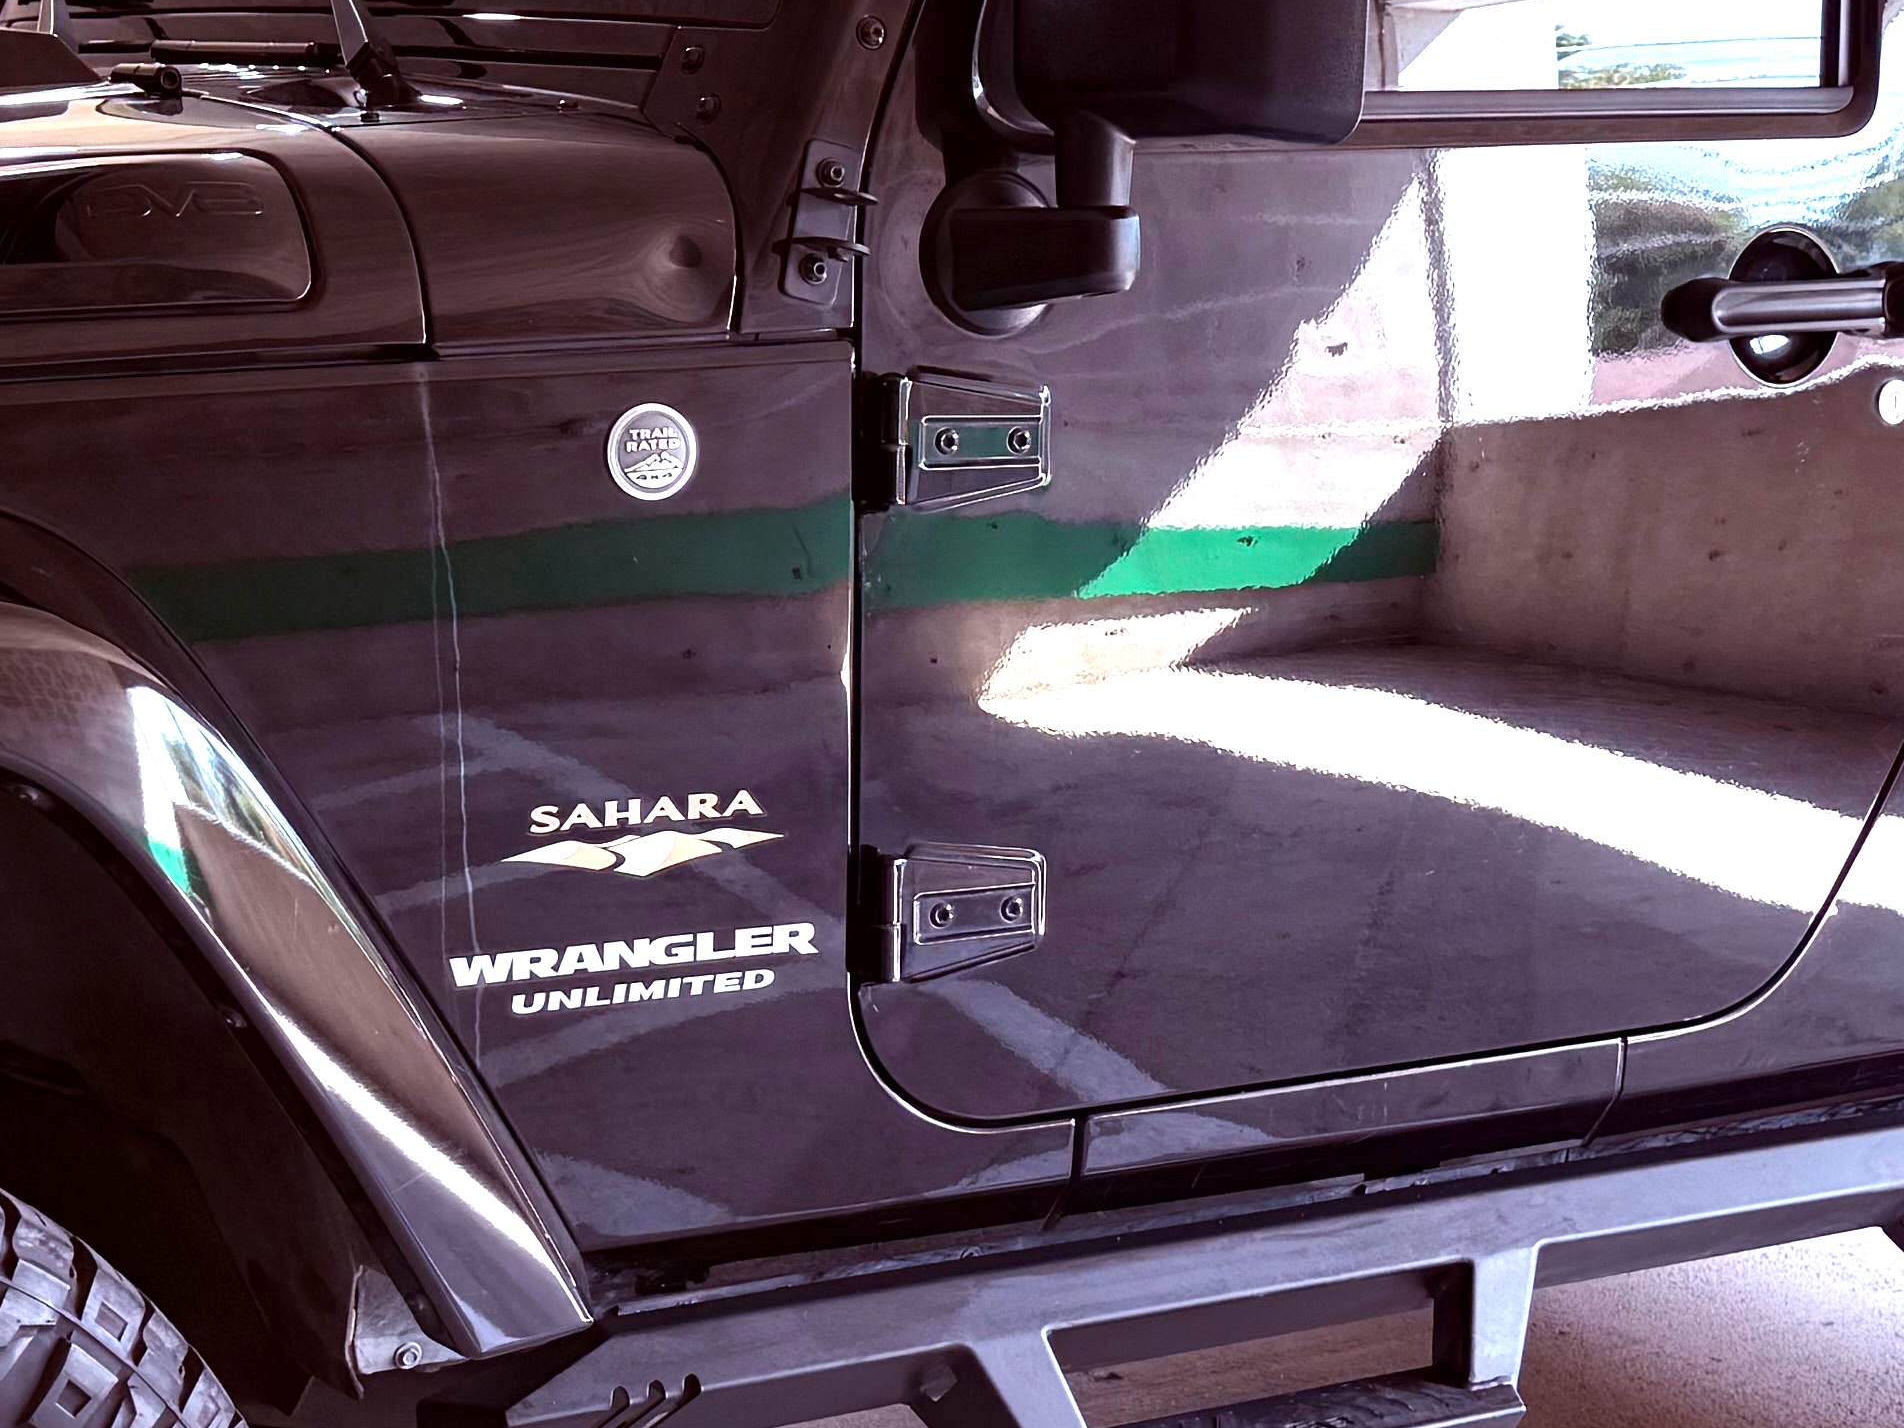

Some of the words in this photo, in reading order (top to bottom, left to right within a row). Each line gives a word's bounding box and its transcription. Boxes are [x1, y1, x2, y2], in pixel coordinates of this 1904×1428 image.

[626, 438, 682, 453] RATED
[629, 426, 679, 441] TRAIL
[529, 789, 764, 835] SAHARA
[449, 922, 819, 988] WRANGLER
[511, 969, 776, 1015] UNLIMITED
